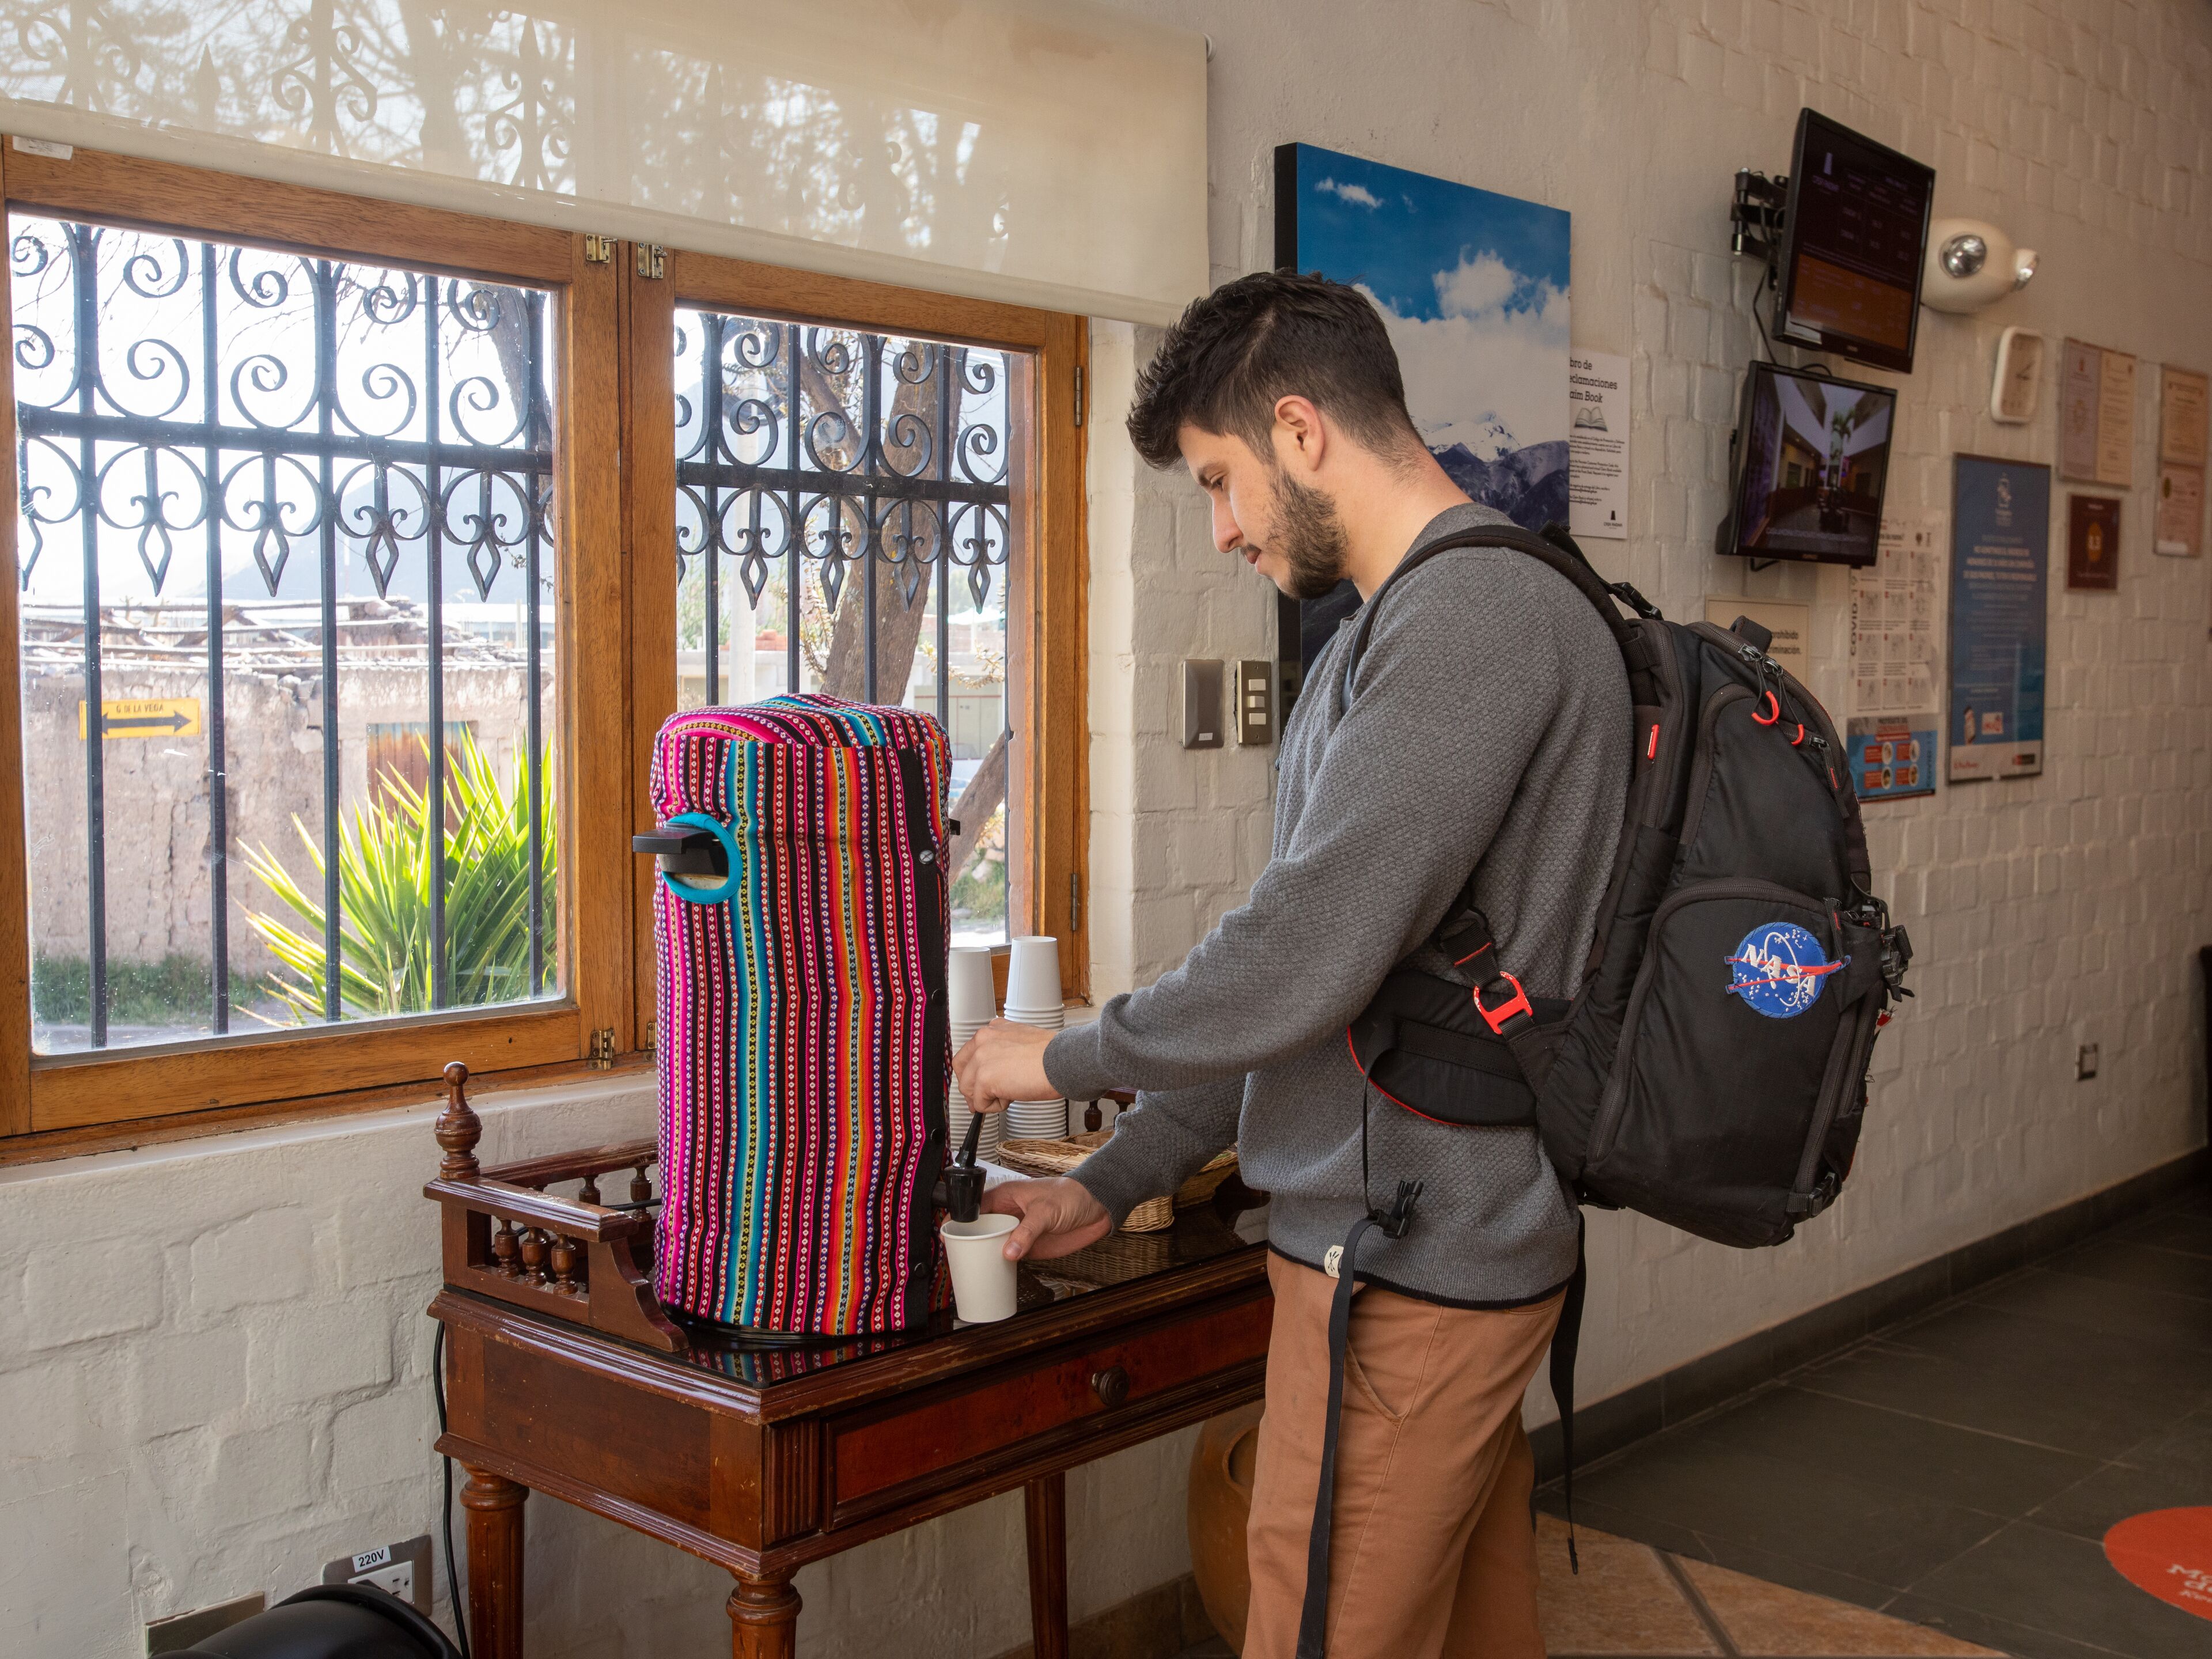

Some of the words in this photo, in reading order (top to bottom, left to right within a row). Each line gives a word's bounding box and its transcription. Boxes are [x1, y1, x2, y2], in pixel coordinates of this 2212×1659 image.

[1570, 357, 1582, 369] bro
[1584, 359, 1592, 370] de
[1570, 374, 1618, 389] eclamaciones
[1570, 389, 1583, 400] aim
[1585, 391, 1603, 403] Book
[134, 704, 142, 713] LA
[145, 703, 164, 713] VEGA
[1741, 944, 1816, 997] NASA
[358, 1549, 385, 1567] 220V
